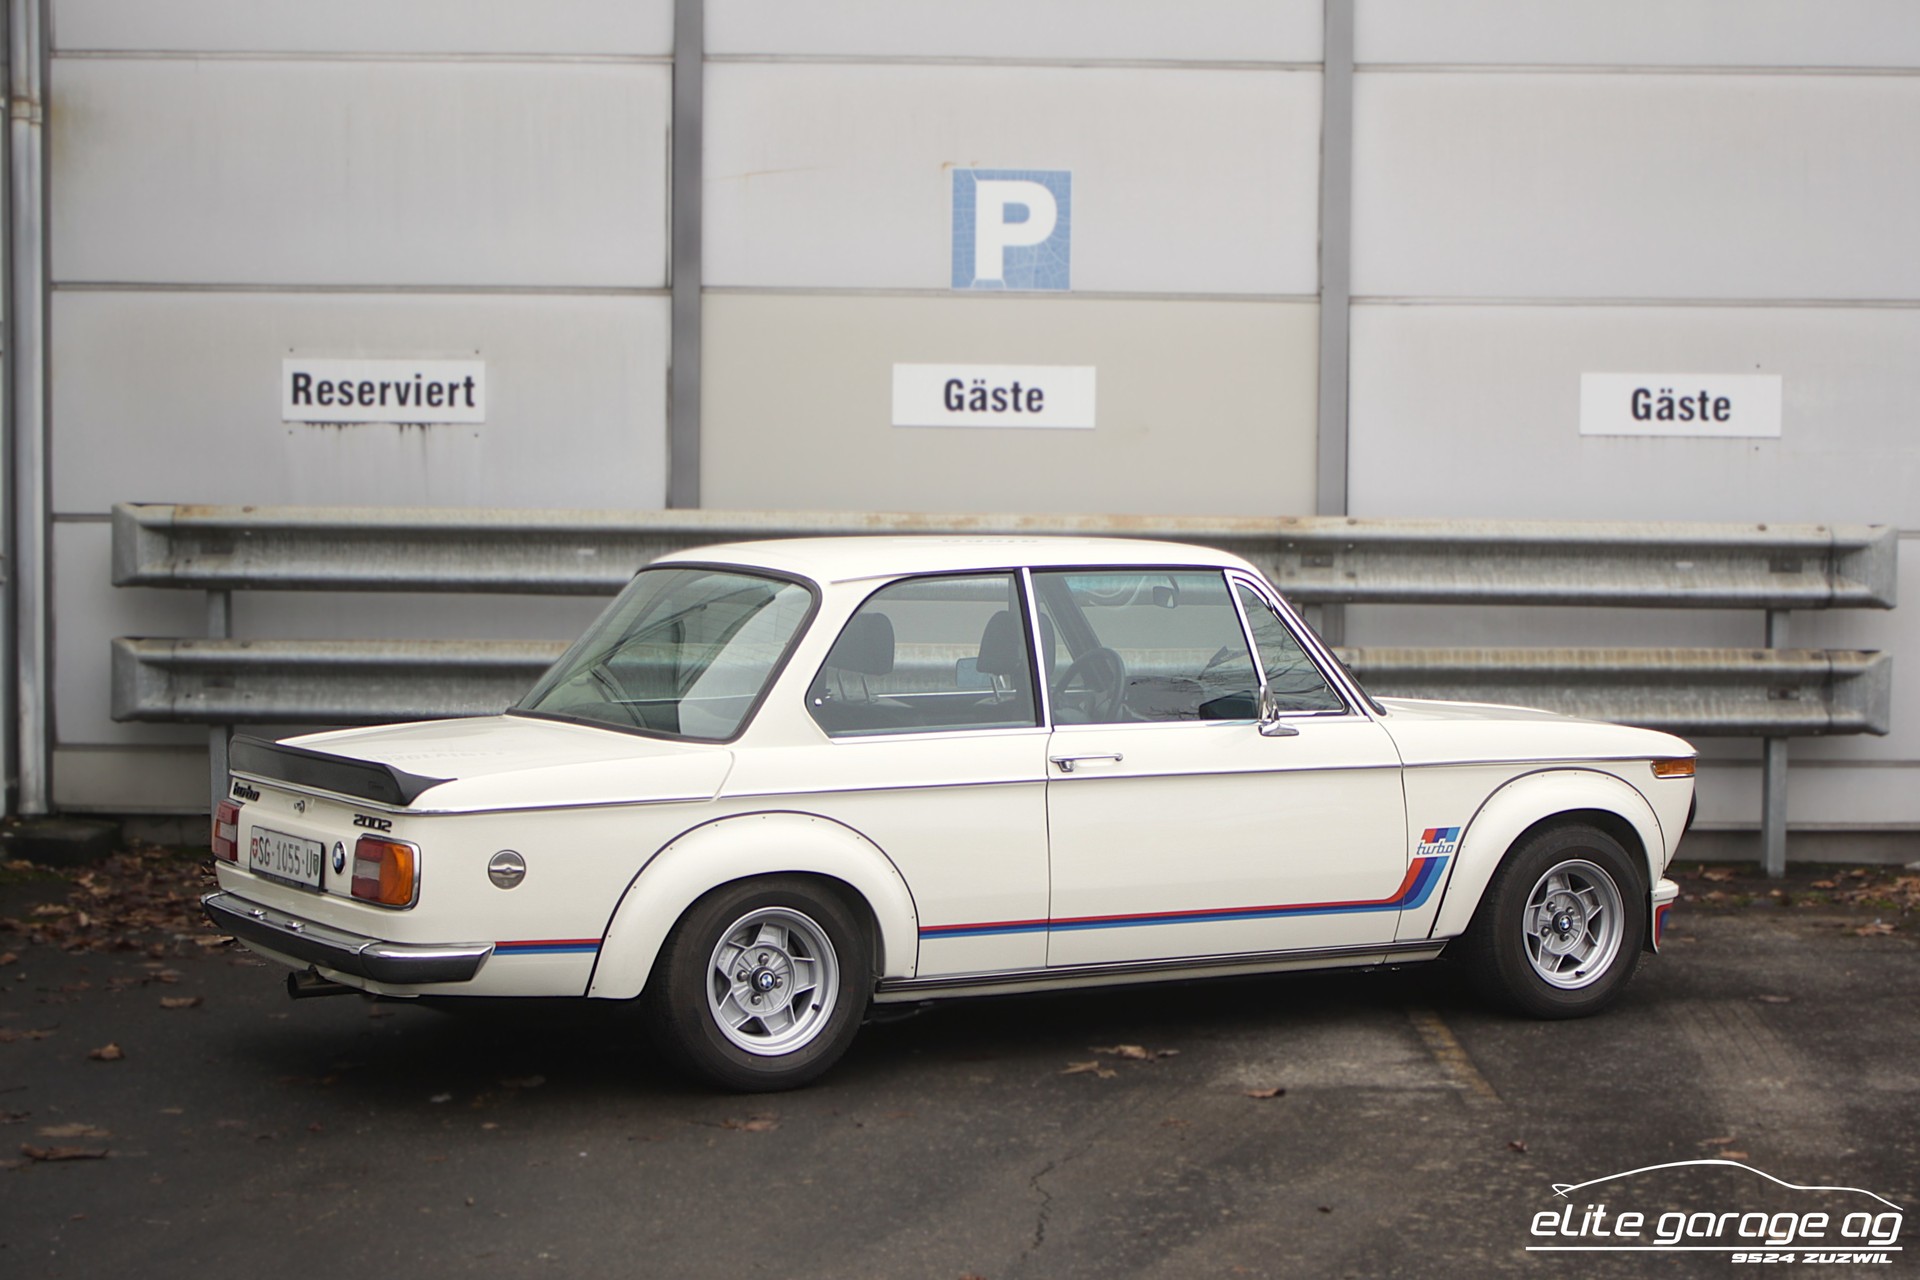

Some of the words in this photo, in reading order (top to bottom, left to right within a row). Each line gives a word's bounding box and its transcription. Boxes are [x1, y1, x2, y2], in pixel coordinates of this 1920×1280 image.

[974, 180, 1057, 280] P
[291, 372, 476, 408] Reserviert
[943, 378, 1045, 413] Gäste
[1630, 387, 1732, 422] Gäste
[353, 813, 393, 833] 2002
[1416, 841, 1455, 856] turbo
